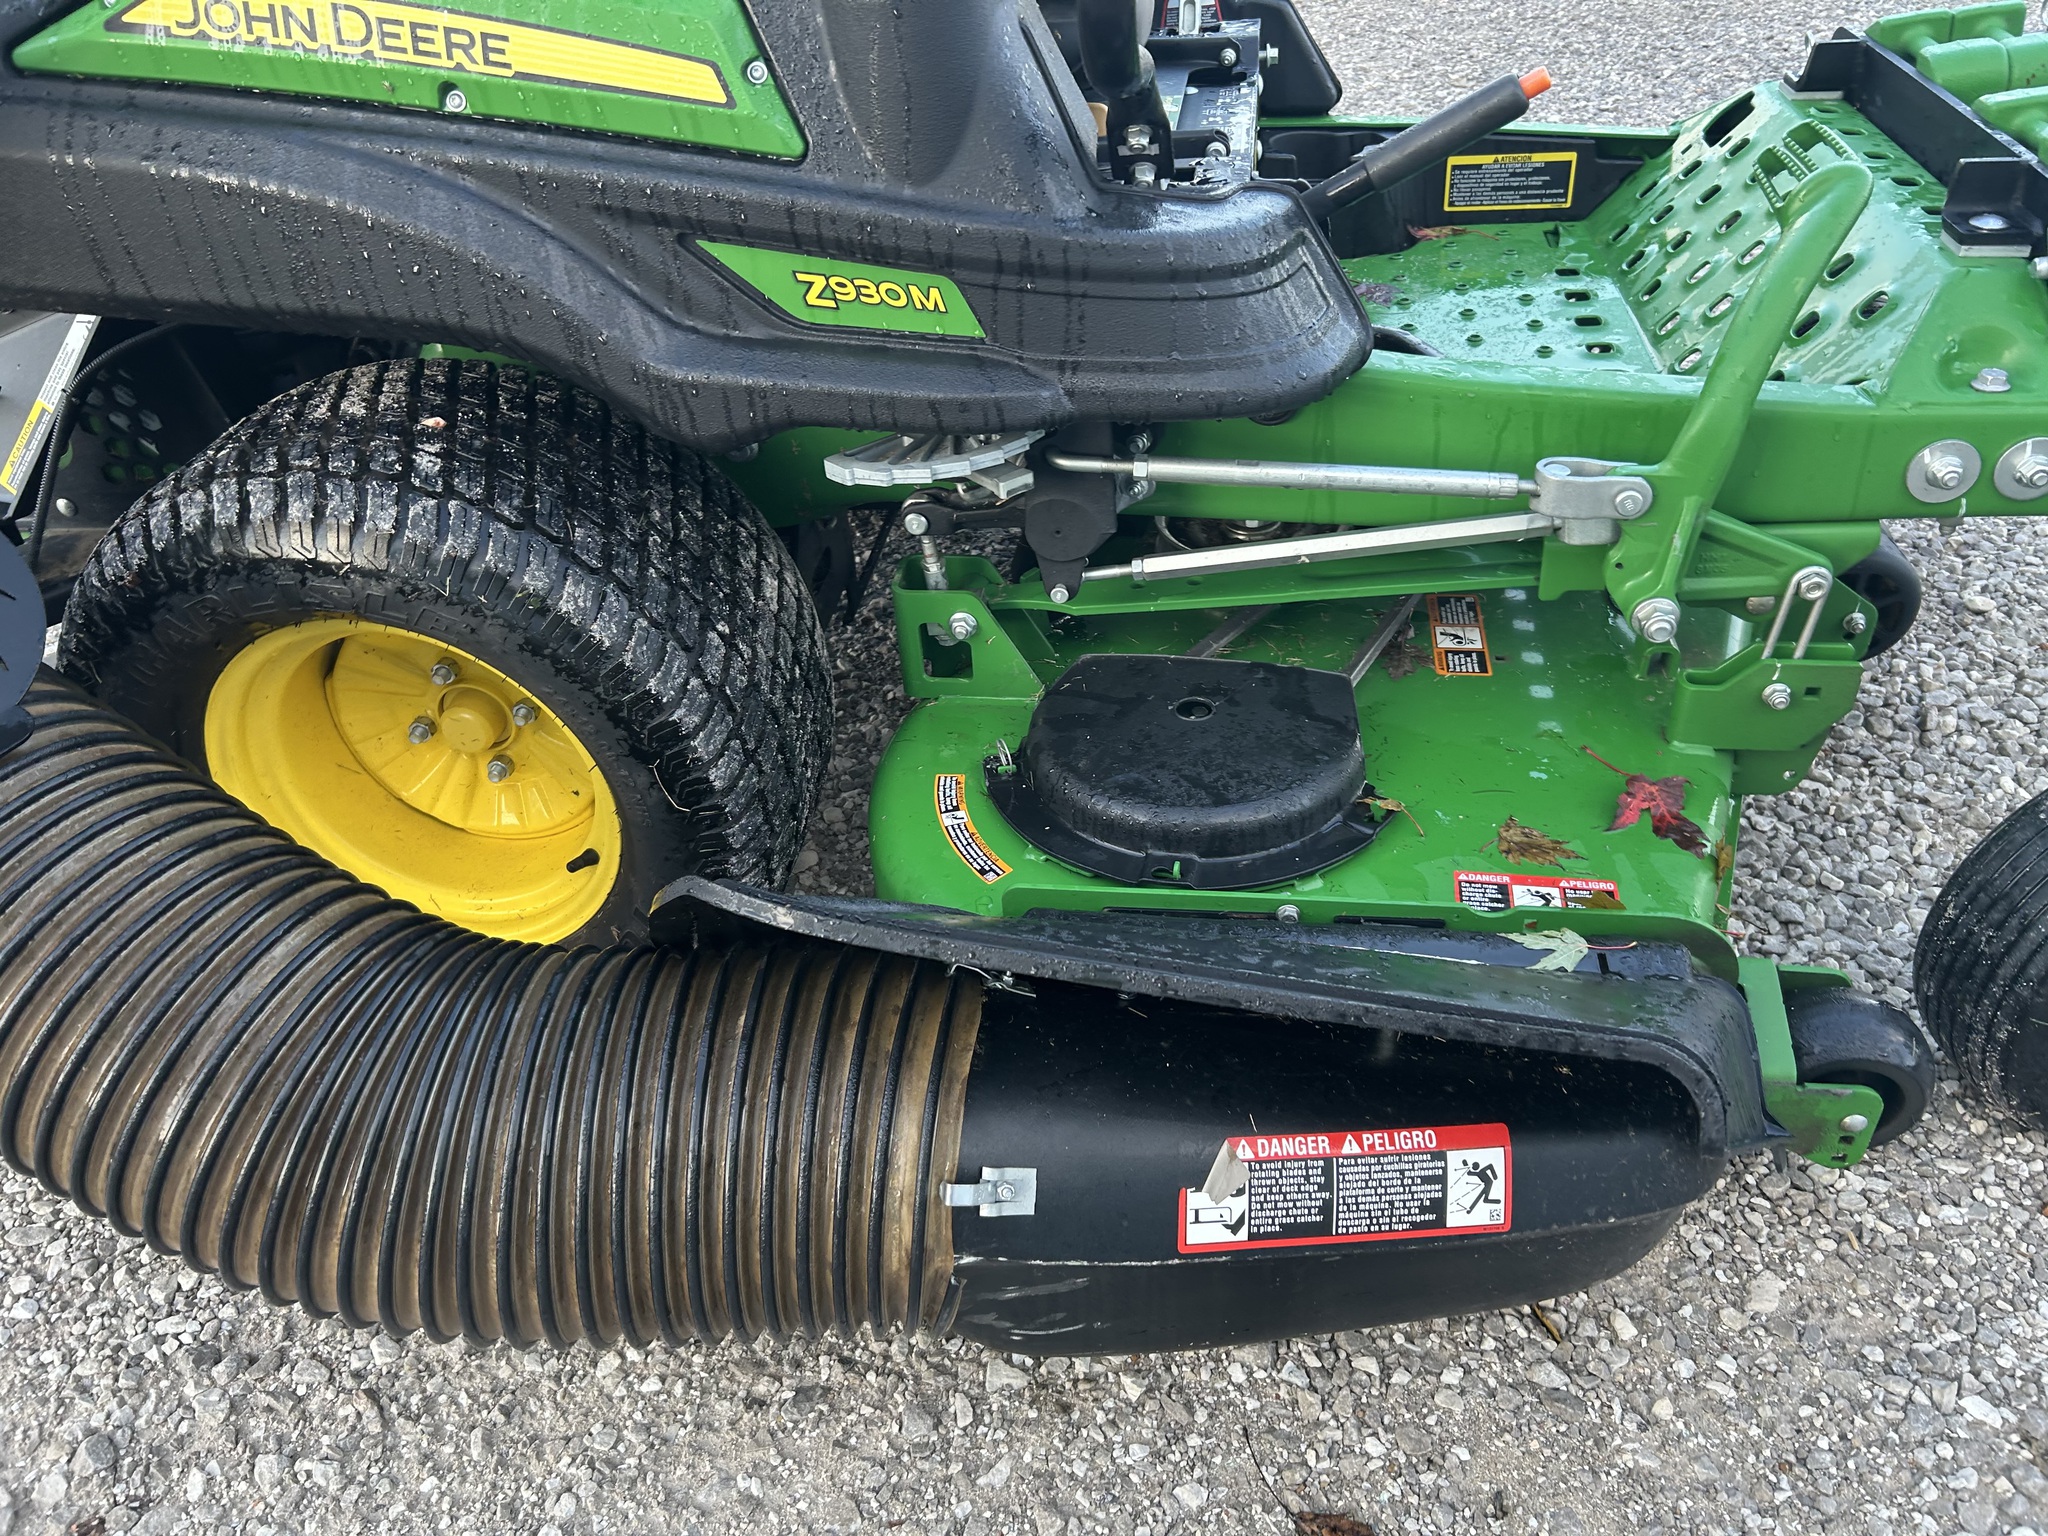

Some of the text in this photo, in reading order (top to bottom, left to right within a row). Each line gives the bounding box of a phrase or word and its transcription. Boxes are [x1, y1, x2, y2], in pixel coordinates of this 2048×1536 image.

[175, 0, 513, 71] JOHN DEERE
[787, 270, 948, 314] Z930M
[12, 419, 34, 460] CAUTION
[1469, 874, 1510, 882] DANGER
[1570, 880, 1614, 890] PELIGRO
[1257, 1135, 1330, 1157] DANGER
[1362, 1130, 1437, 1152] PELIGRO
[1251, 1159, 1324, 1170] To avoid injury from
[1357, 1156, 1378, 1164] evitar
[1380, 1155, 1400, 1163] sufrir
[1338, 1165, 1369, 1173] causadas
[1384, 1162, 1412, 1171] cuchillas
[1414, 1160, 1445, 1170] giratorias
[1251, 1167, 1321, 1179] rotating blades and
[1345, 1172, 1369, 1181] objetos
[1371, 1171, 1403, 1179] lanzados,
[1405, 1169, 1442, 1177] mantenerse
[1251, 1176, 1325, 1186] thrown objects, stay
[1339, 1181, 1365, 1189] alejado
[1251, 1186, 1270, 1194] clear
[1301, 1184, 1318, 1192] edge
[1339, 1187, 1375, 1197] plataforma
[1411, 1184, 1442, 1192] mantener
[1251, 1191, 1332, 1202] and keep others away.
[1358, 1194, 1380, 1203] demás
[1382, 1194, 1412, 1202] personas
[1414, 1191, 1442, 1200] alejadas
[1251, 1202, 1260, 1210] Do
[1263, 1201, 1275, 1209] not
[1296, 1199, 1322, 1207] without
[1338, 1204, 1347, 1212] de
[1359, 1202, 1391, 1212] máquina.
[1251, 1209, 1286, 1218] discharge
[1289, 1208, 1308, 1216] chute
[1338, 1210, 1369, 1220] máquina
[1275, 1217, 1294, 1225] grass
[1297, 1215, 1324, 1223] catcher
[1338, 1219, 1370, 1227] descarga
[1401, 1213, 1436, 1222] recogedor
[1260, 1225, 1283, 1234] place.
[1338, 1226, 1346, 1234] de
[1349, 1224, 1368, 1234] pasto
[1370, 1224, 1378, 1232] en
[1392, 1222, 1412, 1231] lugar.
